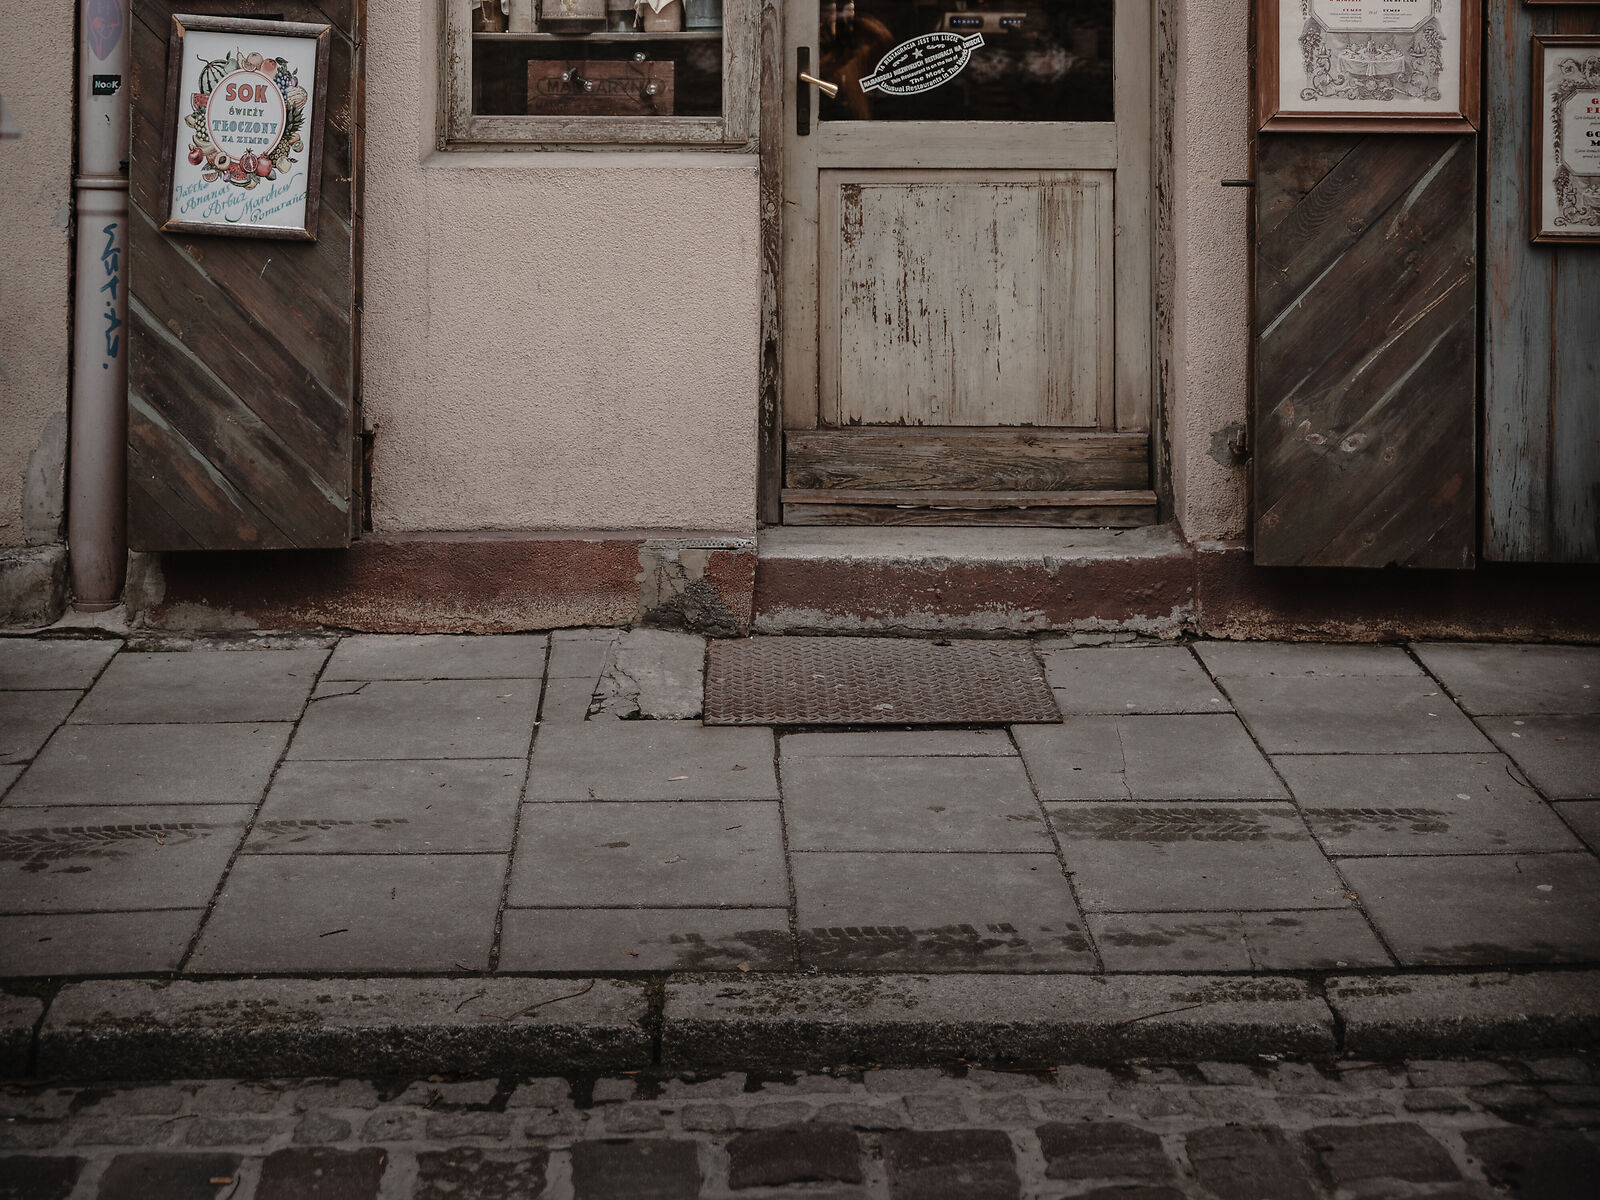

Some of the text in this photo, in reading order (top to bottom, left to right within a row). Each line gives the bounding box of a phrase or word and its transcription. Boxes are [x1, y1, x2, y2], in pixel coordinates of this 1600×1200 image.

[885, 41, 917, 66] RESTAURACJA
[917, 37, 930, 46] JEST
[880, 81, 905, 92] Unusual
[905, 77, 943, 92] Restaurants
[947, 64, 960, 74] The
[909, 67, 946, 85] The Most
[225, 82, 268, 103] SOK
[212, 119, 278, 135] TŁOCZONY
[221, 135, 270, 145] NA ZIMNO
